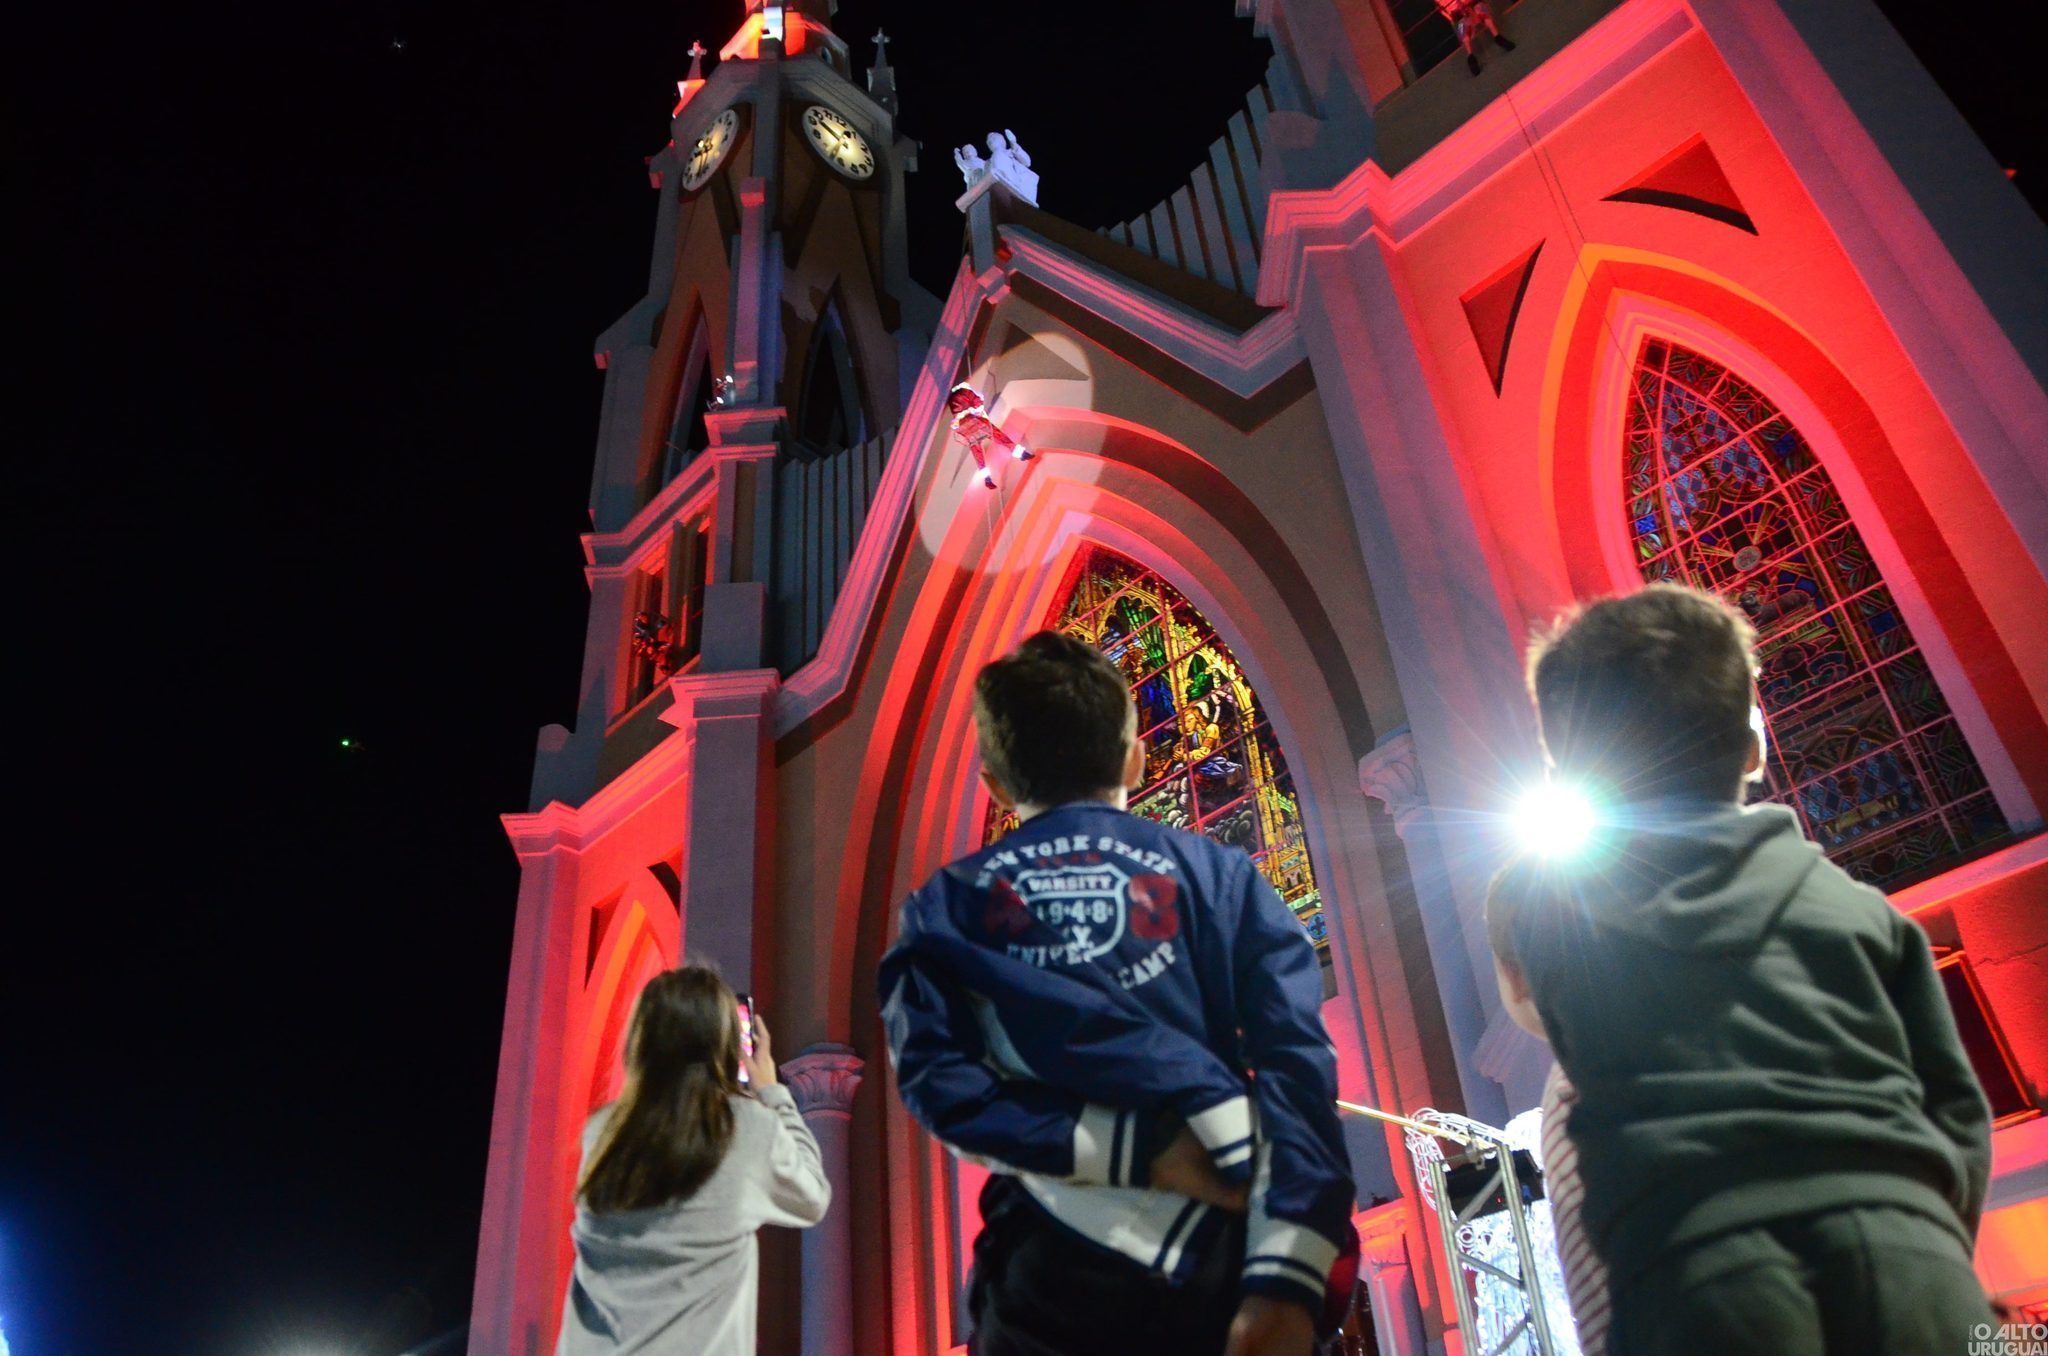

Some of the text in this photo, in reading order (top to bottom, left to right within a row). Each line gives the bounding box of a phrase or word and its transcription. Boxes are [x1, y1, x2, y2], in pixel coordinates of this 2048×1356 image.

[975, 835, 1176, 889] NEW YORK STATE
[1027, 875, 1113, 893] VARSITY
[1118, 941, 1176, 989] CAMP
